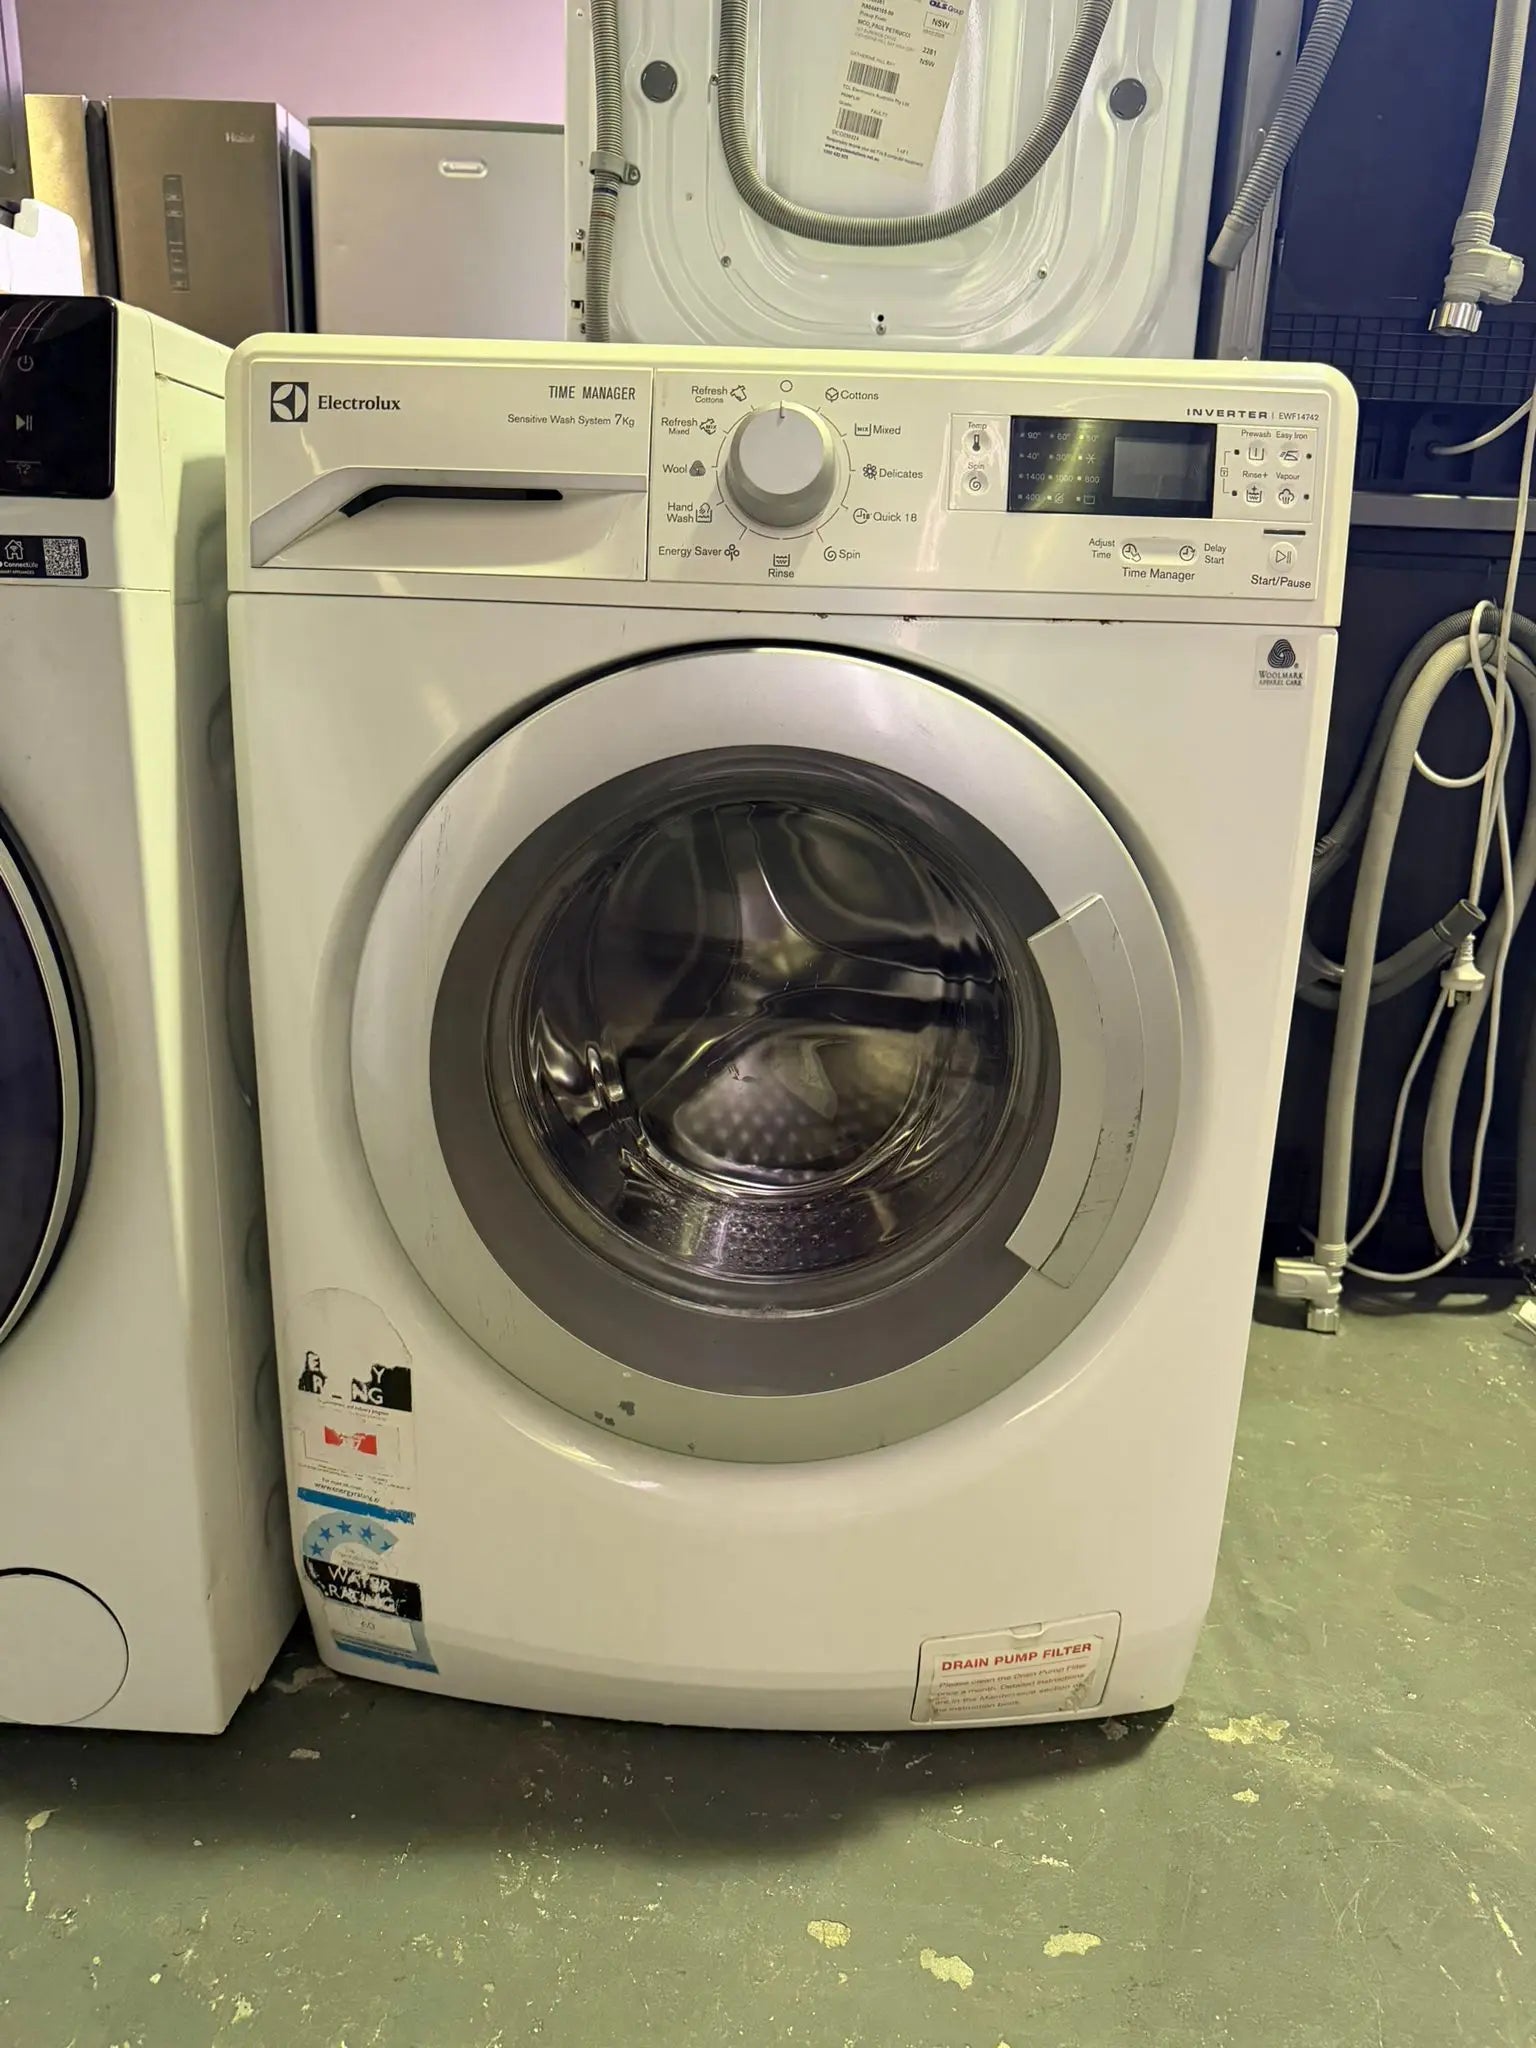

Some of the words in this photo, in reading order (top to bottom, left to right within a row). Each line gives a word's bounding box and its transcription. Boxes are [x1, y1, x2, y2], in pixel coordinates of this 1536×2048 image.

[948, 5, 964, 15] Group
[932, 18, 950, 29] NSW
[922, 46, 937, 56] 2281
[919, 58, 936, 67] NSW
[548, 385, 576, 399] TIME
[582, 386, 636, 400] MANAGER
[691, 385, 728, 395] Refresh
[840, 389, 879, 400] Cottons
[318, 395, 401, 410] Electrolux
[695, 396, 724, 404] Cottons
[507, 413, 548, 424] Sensitive
[550, 415, 576, 425] Wash
[578, 415, 612, 427] System
[1187, 408, 1268, 419] INVERTER
[1279, 412, 1320, 421] EWF14742
[661, 416, 698, 427] Refresh
[968, 421, 988, 430] Temp
[873, 424, 901, 435] Mixed
[1241, 429, 1272, 438] Prewash
[1276, 430, 1293, 440] Easy
[1293, 431, 1308, 440] Iron
[662, 464, 688, 474] Wool
[968, 462, 985, 470] Spin
[879, 468, 923, 479] Delicates
[1275, 472, 1300, 481] Vapour
[667, 501, 694, 512] Hand
[667, 513, 694, 523] Wash
[873, 511, 902, 522] Quick
[905, 512, 918, 522] 18
[658, 545, 692, 558] Energy
[694, 546, 722, 556] Saver
[1089, 538, 1115, 548] Adjust
[1204, 543, 1227, 554] Delay
[839, 548, 861, 560] Spin
[1092, 550, 1111, 559] Time
[1204, 555, 1225, 565] Start
[768, 568, 795, 578] Rinse
[1122, 567, 1147, 578] Time
[1149, 568, 1195, 583] Manager
[1250, 574, 1312, 589] Start/Pause
[1258, 670, 1303, 680] WOOLMARK
[942, 1658, 989, 1671] DRAIN
[994, 1652, 1038, 1666] PUMP
[1043, 1643, 1092, 1660] FILTER
[939, 1680, 969, 1689] Please
[971, 1677, 996, 1686] clean
[997, 1674, 1012, 1682] the
[1013, 1672, 1037, 1681] Drain
[1038, 1668, 1065, 1678] Pump
[1066, 1663, 1087, 1671] Filter
